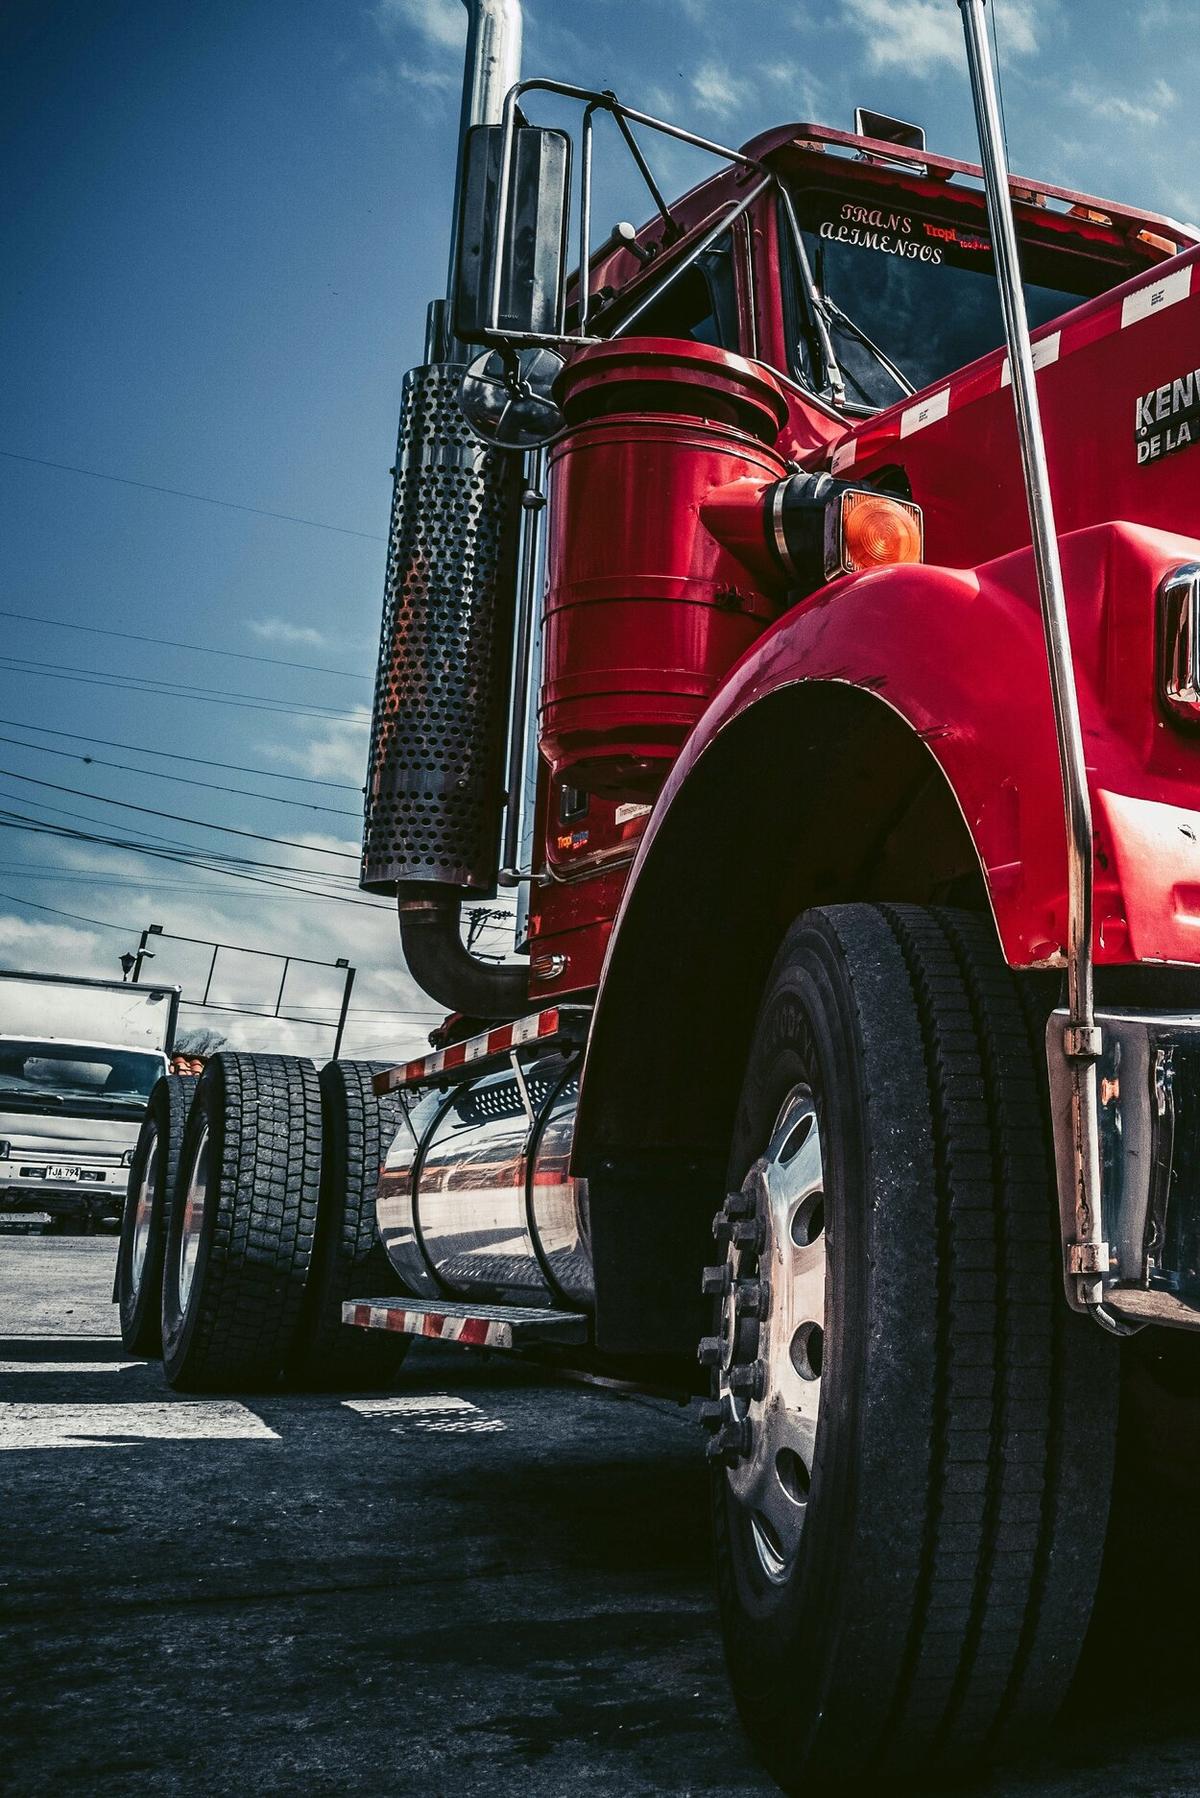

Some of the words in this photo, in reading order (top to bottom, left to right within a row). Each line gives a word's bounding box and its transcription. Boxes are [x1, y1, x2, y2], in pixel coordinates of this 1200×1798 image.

[840, 203, 912, 234] TRANS
[819, 221, 942, 265] ALIMENTOS
[1137, 434, 1161, 464] DE
[1166, 421, 1192, 451] LA
